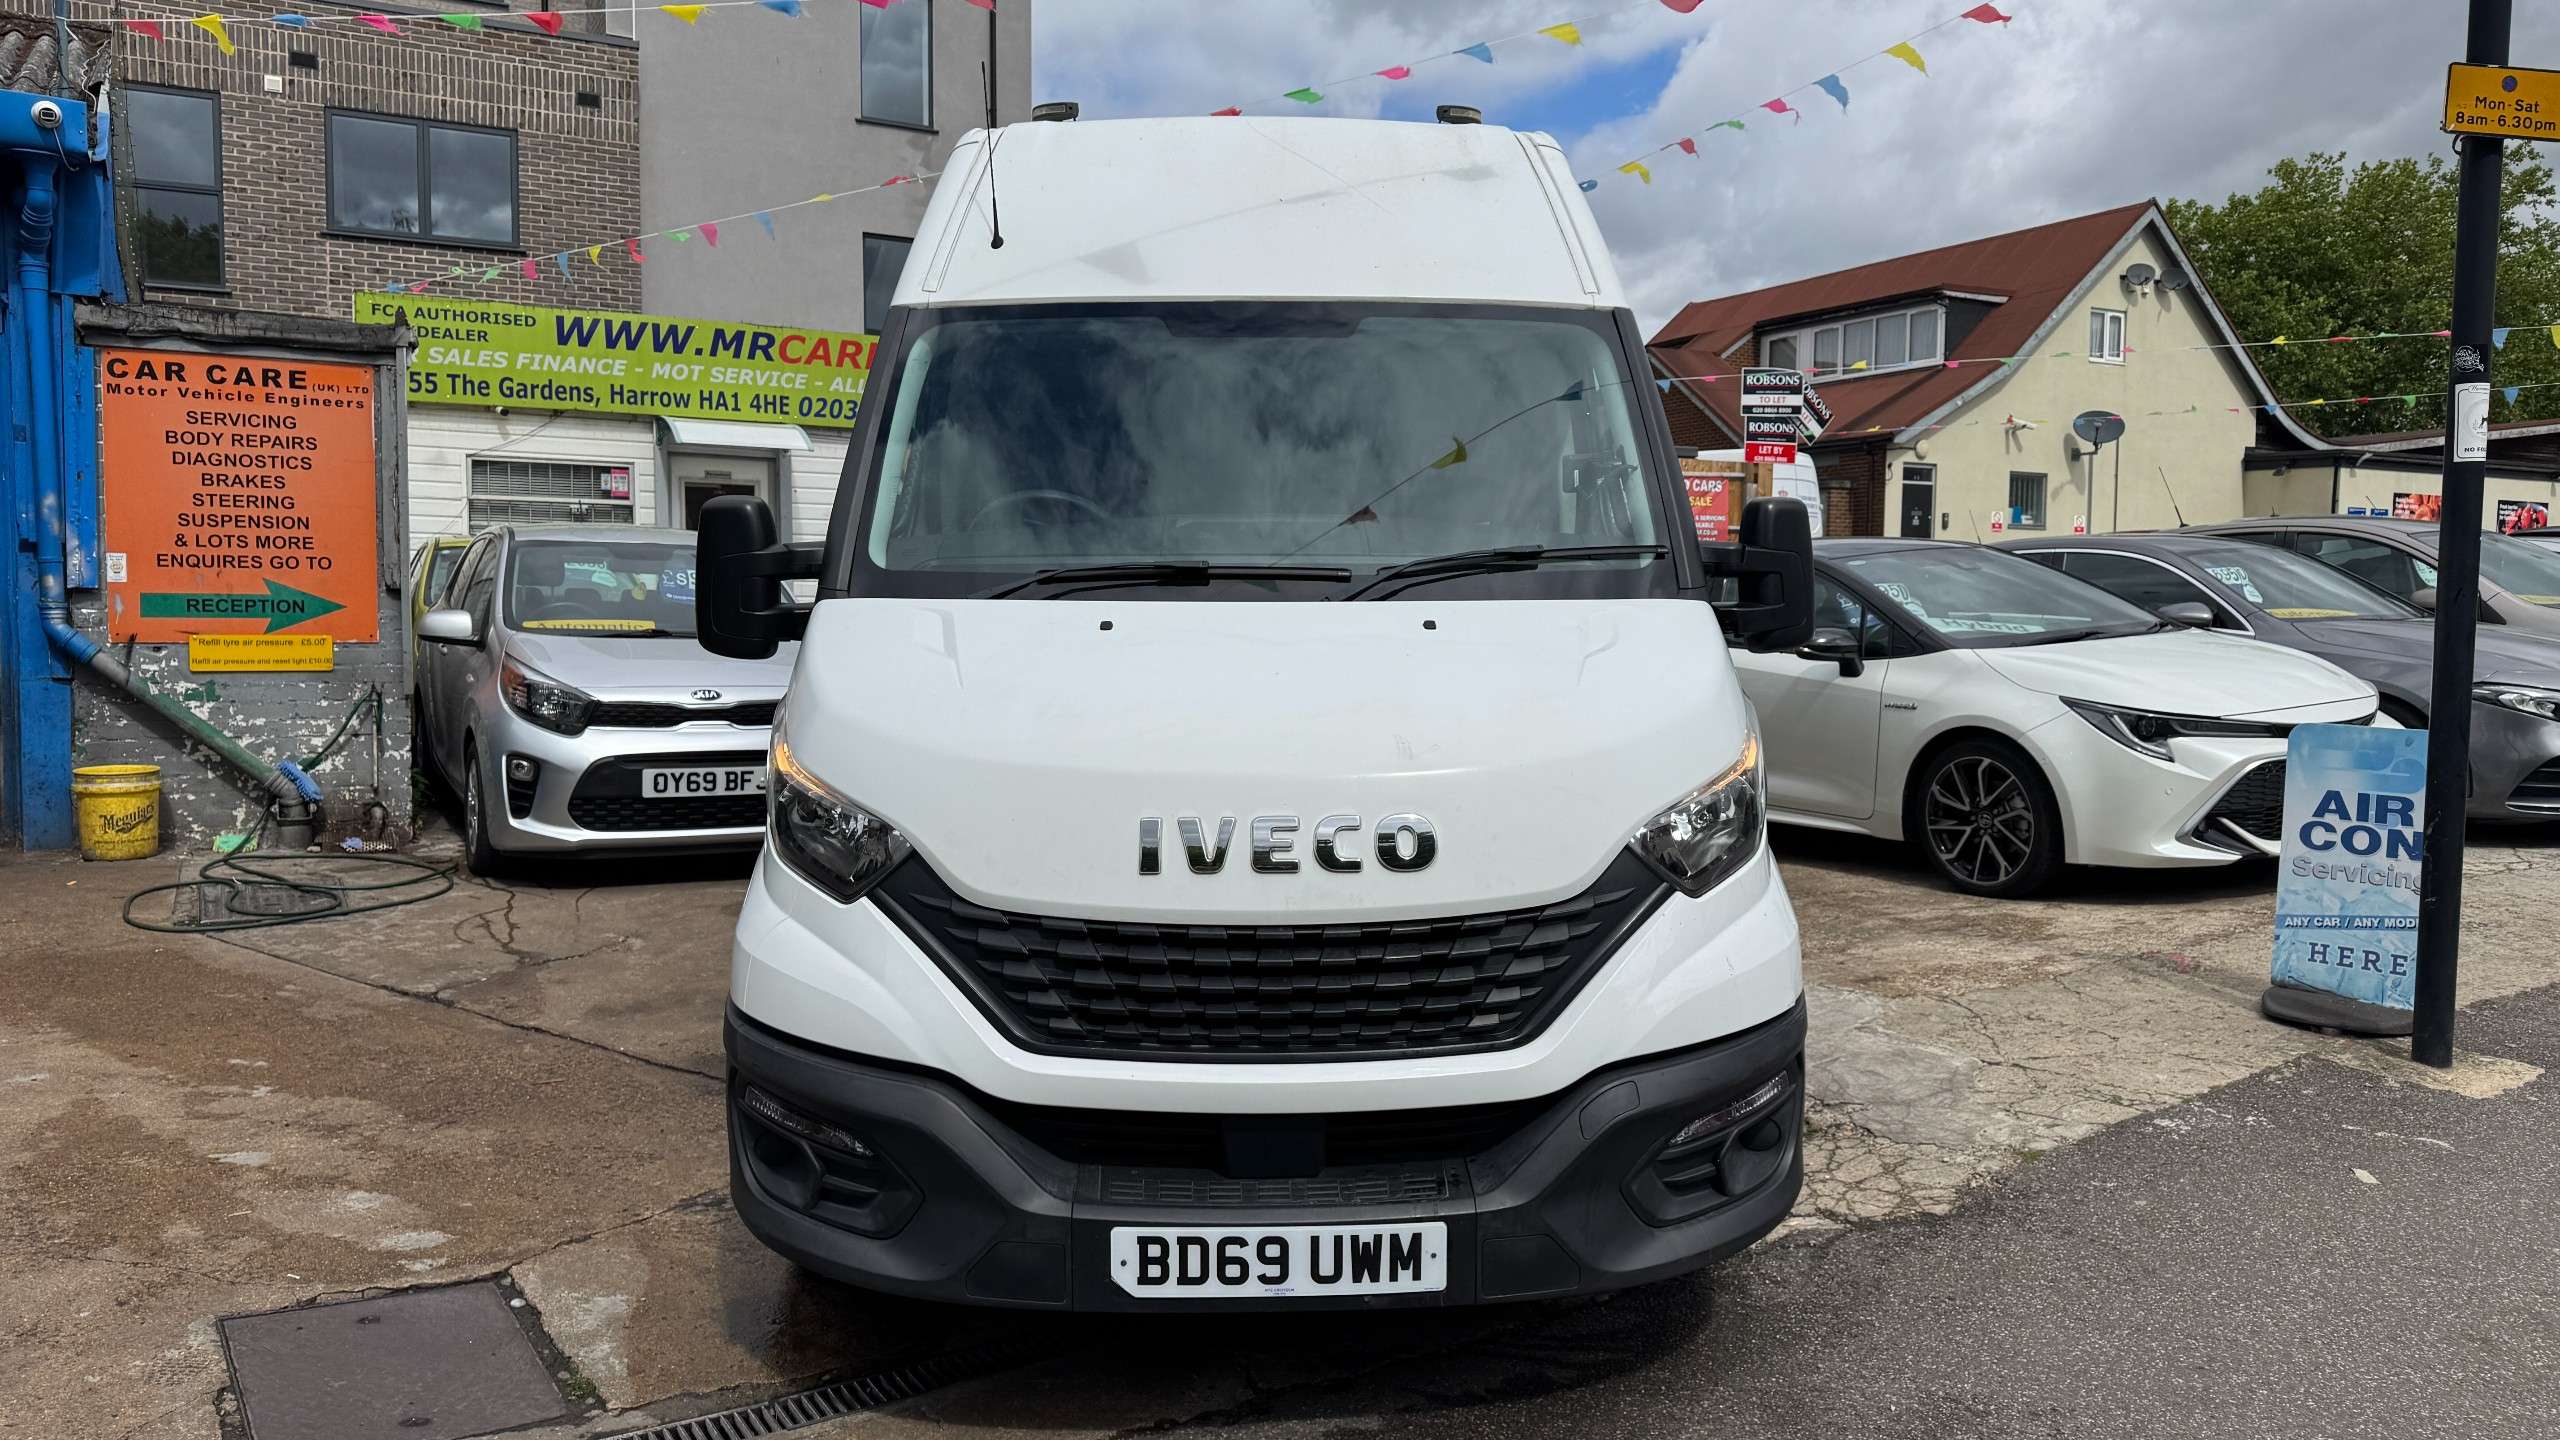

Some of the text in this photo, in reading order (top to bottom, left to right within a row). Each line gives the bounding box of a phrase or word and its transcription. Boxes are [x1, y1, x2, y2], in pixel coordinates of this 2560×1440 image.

[414, 306, 537, 327] AUTHORISED
[417, 326, 489, 342] DEALER
[106, 357, 369, 394] CAR CARE (UK) LTD
[427, 347, 508, 369] SALES
[516, 352, 627, 376] FINANCE
[651, 362, 704, 382] MOT
[710, 366, 808, 389] SERVICE
[1746, 374, 1800, 385] ROBSONS
[106, 383, 365, 409] Motor Vehicle Engineers
[409, 372, 858, 420] 55 The Gardens, Harrow HA1 4HE 0203
[1803, 383, 1832, 420] OBSONS
[186, 410, 297, 430] SERVICING
[1748, 421, 1795, 433] ROBSONS
[165, 430, 318, 451] BODY REPAIRS
[1759, 445, 1784, 454] LET BY
[172, 451, 313, 470] DIAGNOSTICS
[201, 472, 286, 489] BRAKES
[1693, 479, 1723, 492] CARS
[192, 492, 295, 510] STEERING
[1689, 495, 1713, 507] SALE
[177, 512, 310, 530] SUSPENSION
[174, 533, 314, 550] & LOTS MORE
[156, 553, 333, 570] ENQUIRES GO TO
[186, 598, 305, 614] RECEPTION
[1942, 618, 2028, 633] Hybrid
[223, 638, 239, 647] tyre
[242, 638, 253, 646] air
[255, 639, 293, 648] pressure
[223, 658, 255, 666] pressure
[257, 657, 270, 665] and
[653, 771, 717, 794] OY69
[2311, 789, 2415, 827] AIR
[1138, 812, 1439, 875] IVECO
[2299, 820, 2424, 862] CON
[2284, 916, 2418, 929] ANY CAR / ANY MOD
[2307, 941, 2409, 977] HERE
[1137, 1232, 1422, 1286] BD69 UWM
